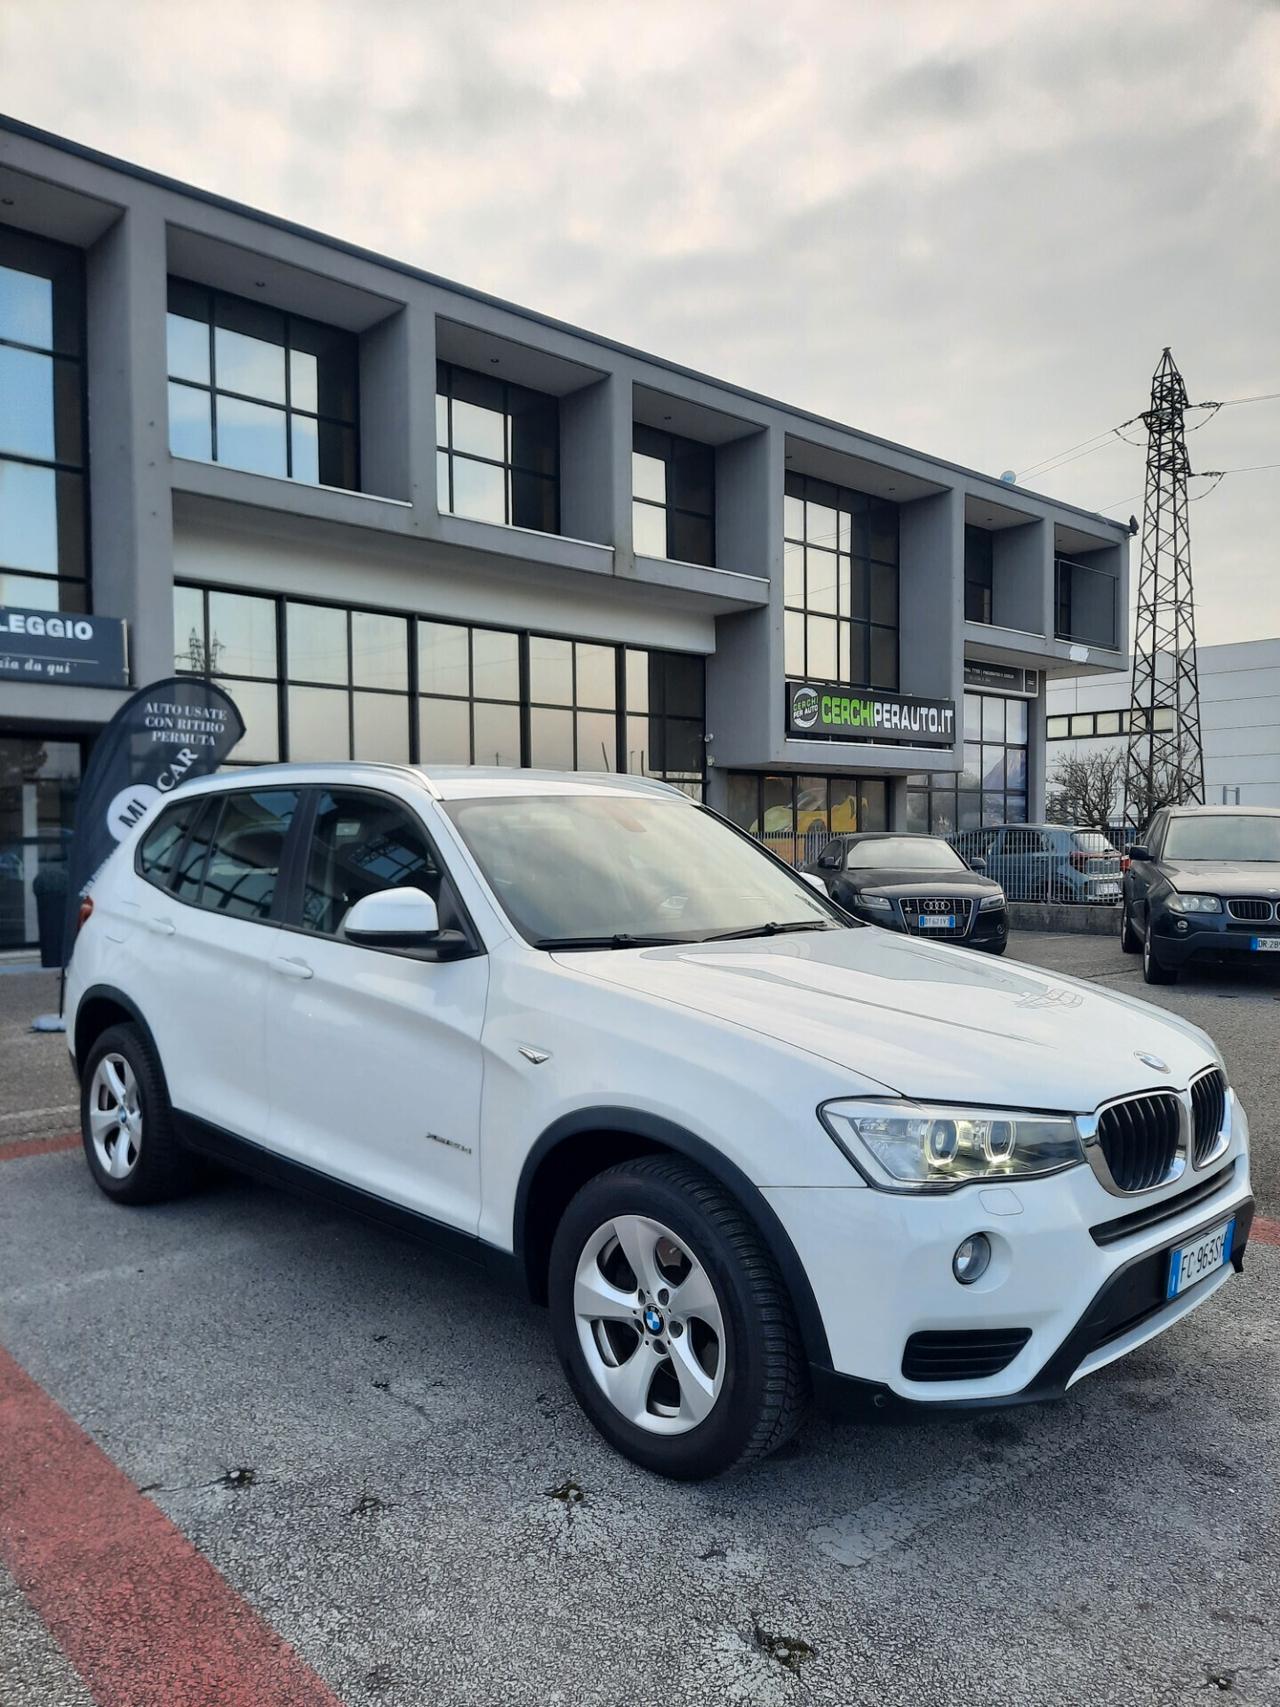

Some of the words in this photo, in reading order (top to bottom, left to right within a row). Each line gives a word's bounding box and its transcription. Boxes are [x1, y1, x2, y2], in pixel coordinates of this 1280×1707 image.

[24, 659, 42, 672] da
[144, 702, 182, 716] AUTO
[185, 705, 228, 720] USATE
[804, 704, 819, 715] AUTO
[821, 695, 954, 734] CERCHIPERAUTO.IT
[144, 716, 174, 728] CON
[176, 719, 225, 733] RITIRO
[152, 731, 216, 746] PERMUTA
[118, 798, 148, 829] MI
[156, 747, 199, 792] CAR
[1180, 1251, 1195, 1283] FC
